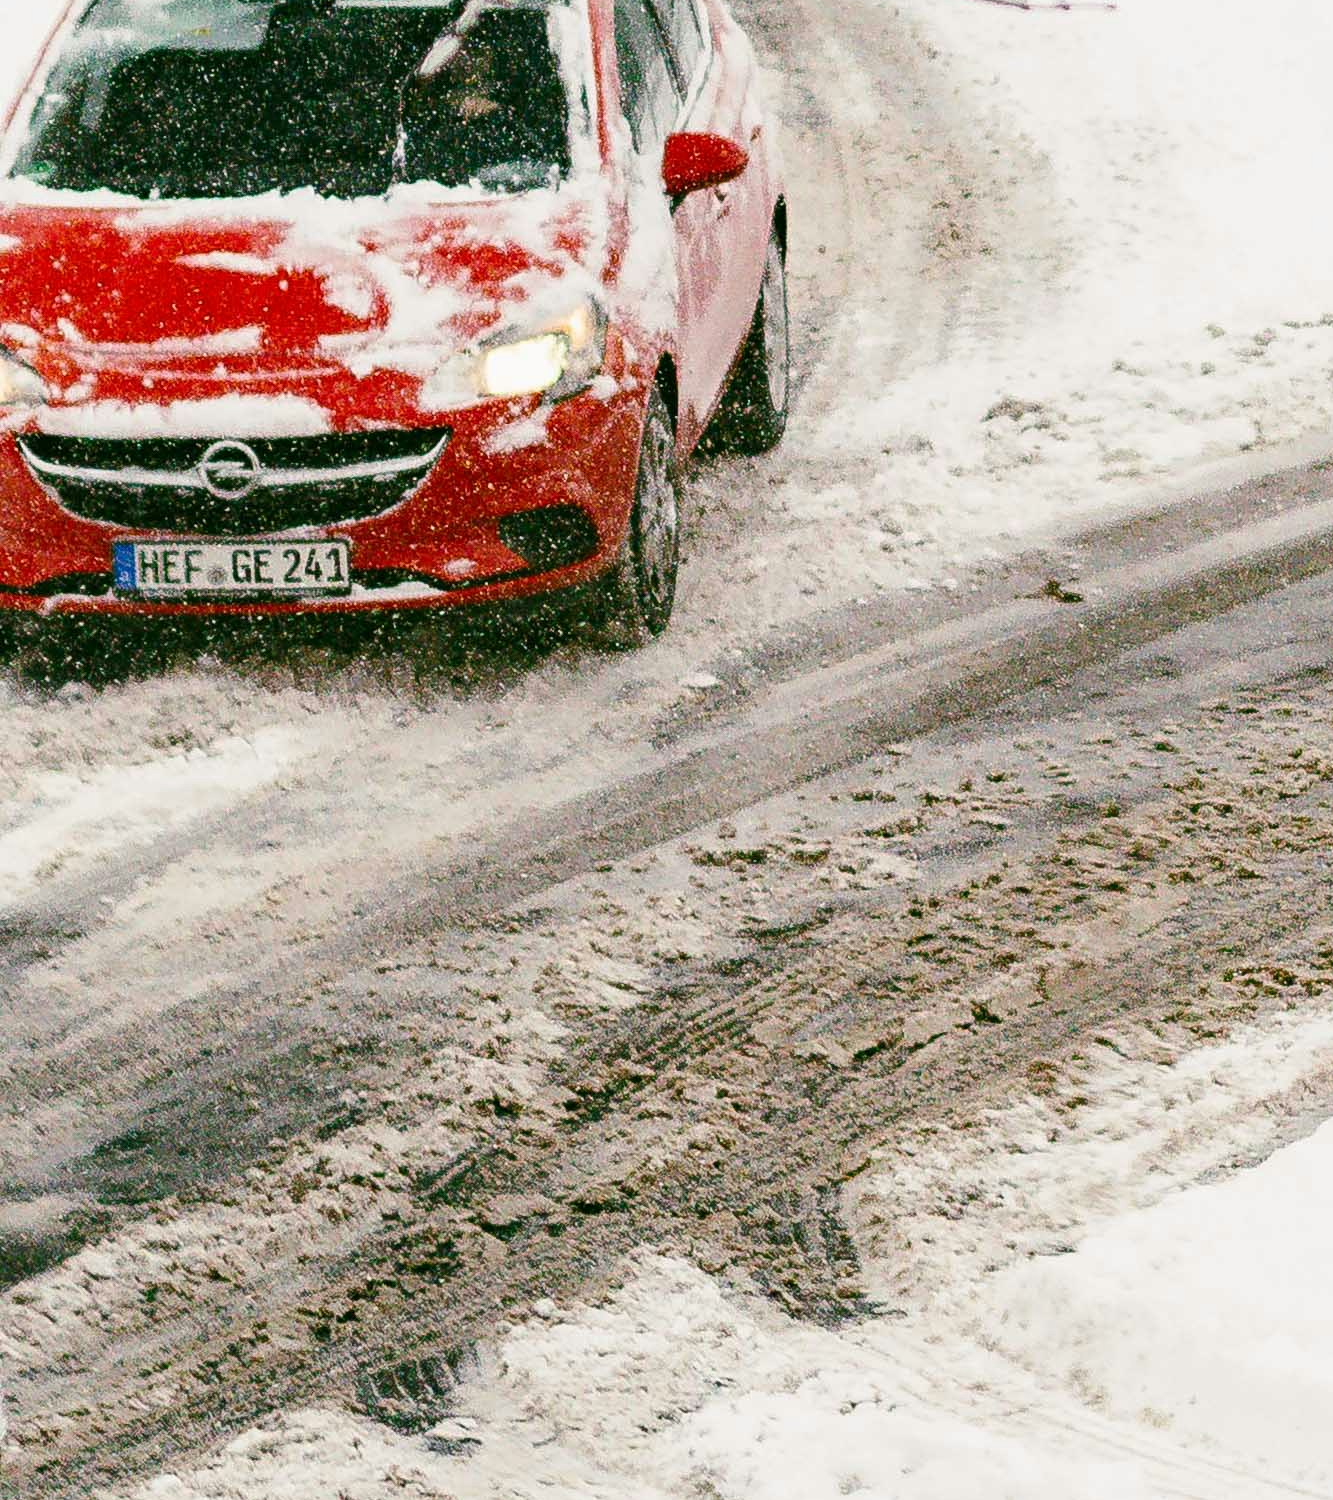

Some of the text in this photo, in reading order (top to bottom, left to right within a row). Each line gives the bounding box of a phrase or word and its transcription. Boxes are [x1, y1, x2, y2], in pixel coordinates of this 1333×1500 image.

[139, 548, 345, 584] HEF GE 241
